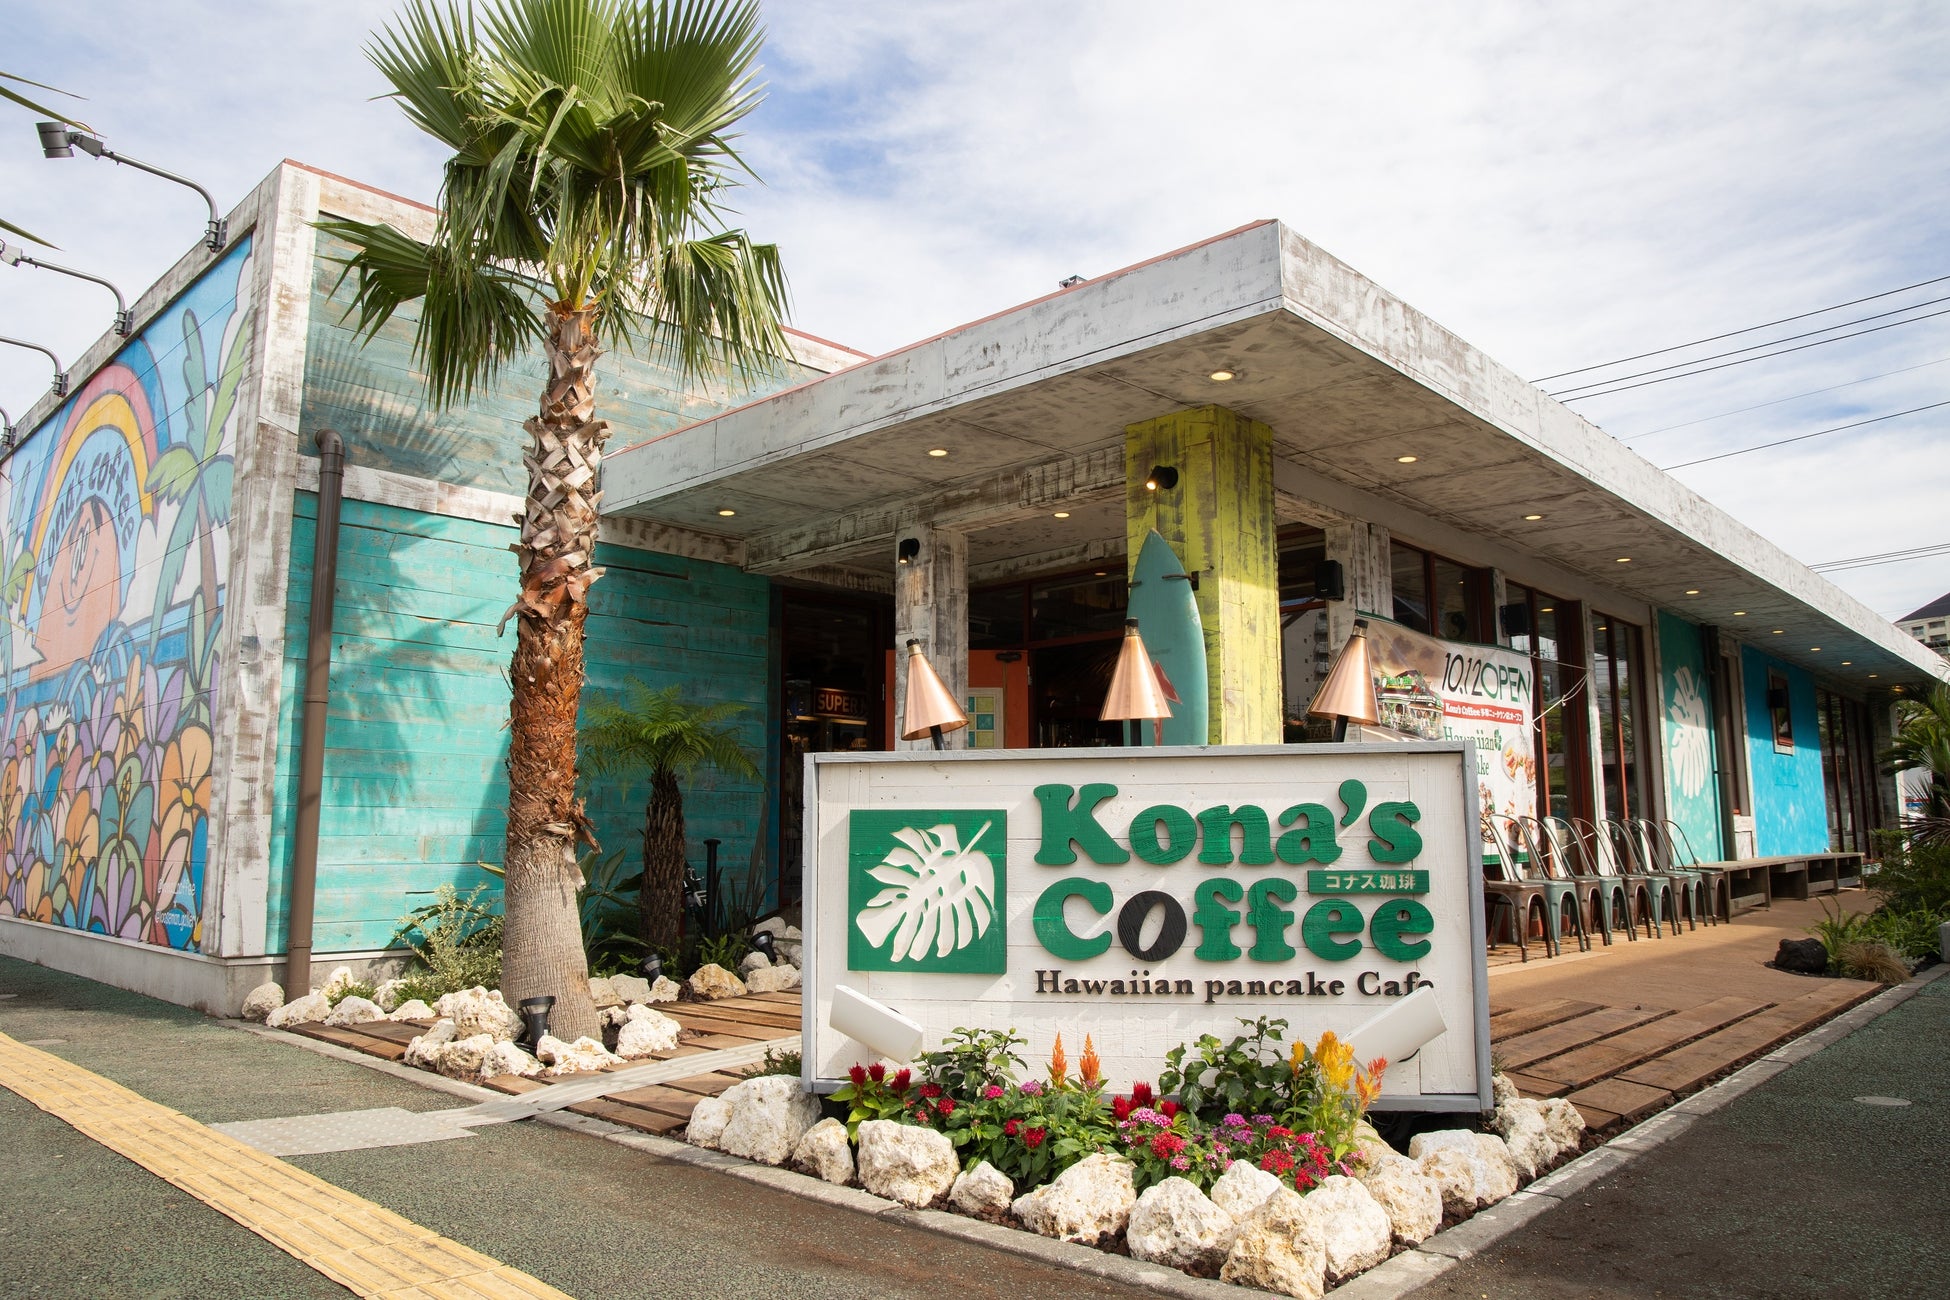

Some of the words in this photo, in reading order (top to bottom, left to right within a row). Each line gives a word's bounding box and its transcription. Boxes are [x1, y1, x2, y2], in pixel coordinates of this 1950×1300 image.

[1033, 778, 1424, 866] Kona's
[1326, 873, 1416, 890] コナス珈琲
[1033, 876, 1435, 962] Coffee
[1035, 970, 1195, 997] Hawaiian
[1204, 971, 1345, 1003] pancake
